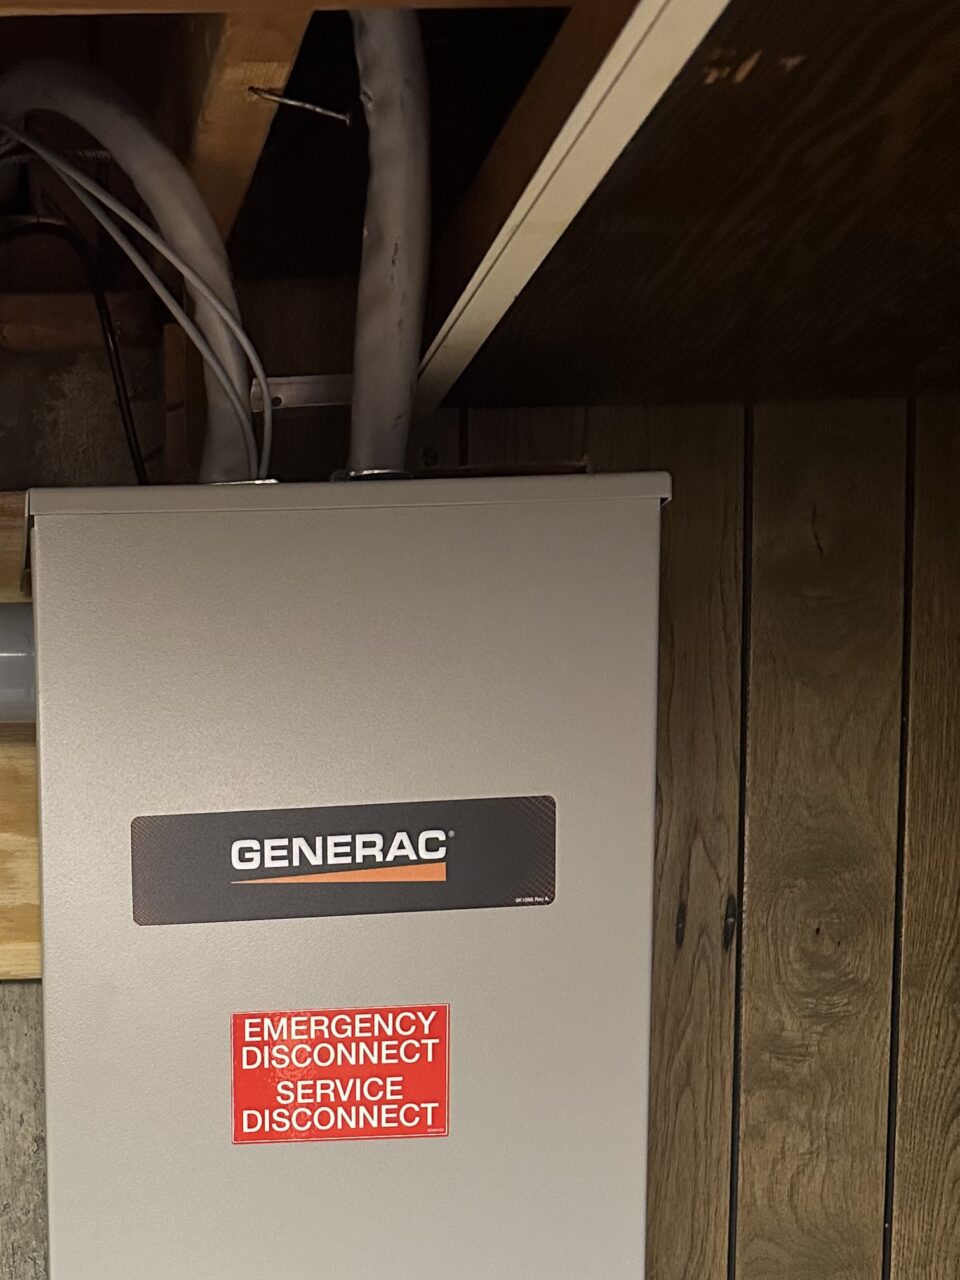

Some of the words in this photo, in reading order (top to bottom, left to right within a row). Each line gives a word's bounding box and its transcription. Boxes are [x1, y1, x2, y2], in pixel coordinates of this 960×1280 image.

[230, 829, 447, 870] GENERAC
[244, 1010, 438, 1042] EMERGENCY
[242, 1038, 440, 1070] DISCONNECT
[276, 1076, 404, 1105] SERVICE
[242, 1102, 440, 1133] DISCONNECT
